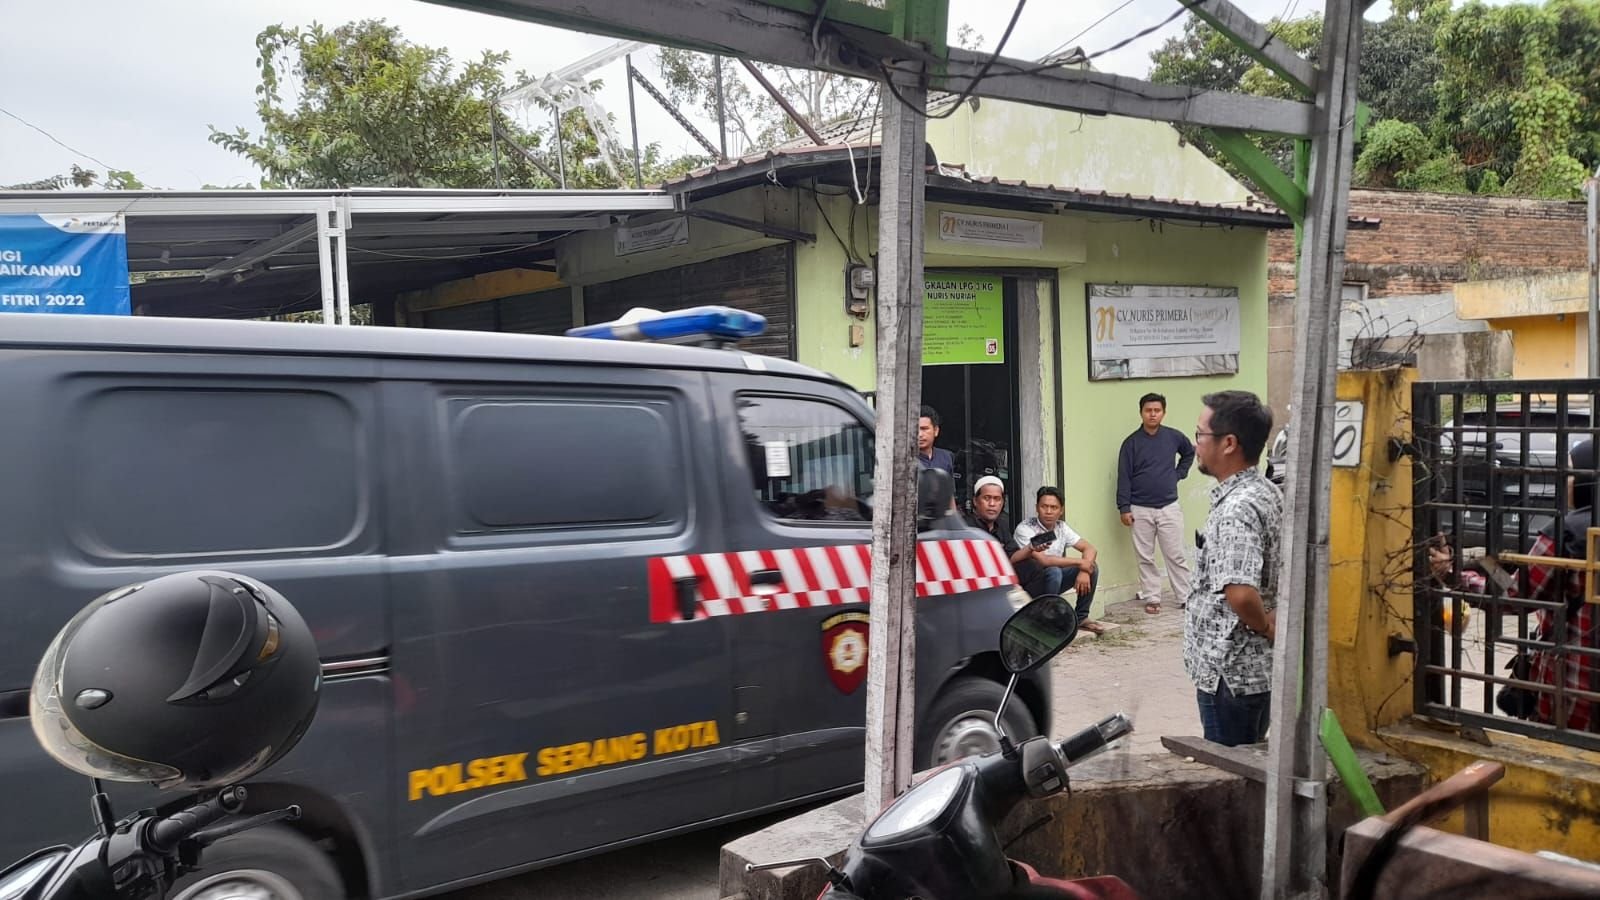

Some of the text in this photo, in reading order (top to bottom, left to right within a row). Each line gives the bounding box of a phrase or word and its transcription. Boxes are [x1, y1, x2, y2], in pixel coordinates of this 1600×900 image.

[0, 250, 21, 262] GI
[924, 281, 957, 290] GKALAN
[959, 282, 974, 290] LPG
[2, 294, 86, 306] FITRI 2022
[927, 292, 976, 300] NURIS NURIAH
[1156, 308, 1188, 321] PRIMERA
[408, 720, 720, 801] POLSEK SERANG KOTA
